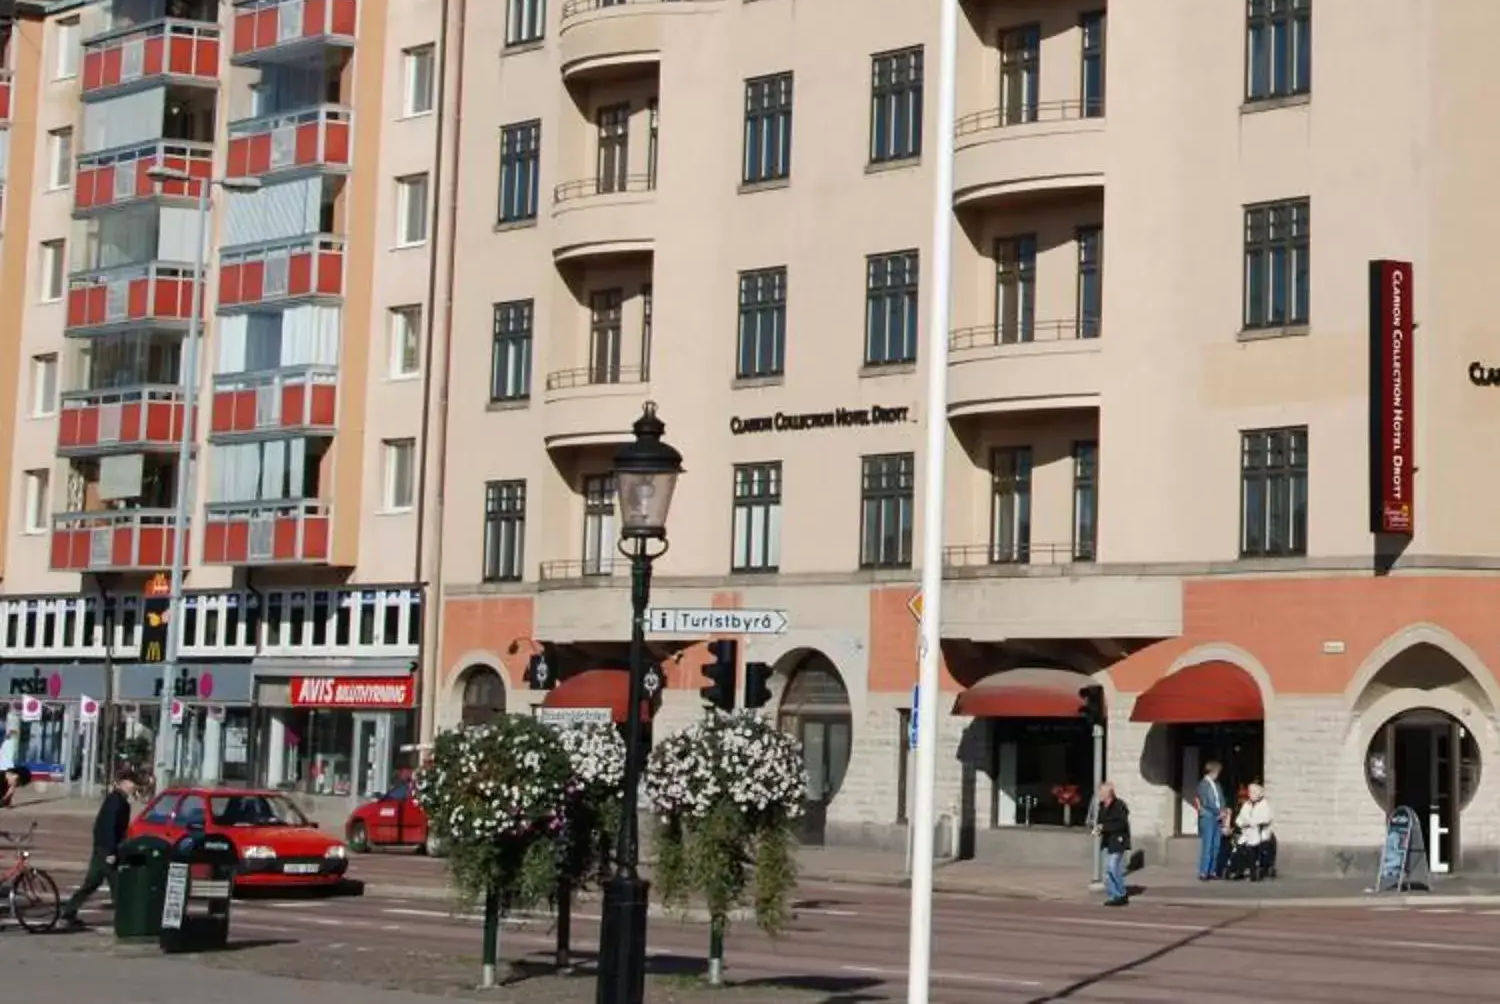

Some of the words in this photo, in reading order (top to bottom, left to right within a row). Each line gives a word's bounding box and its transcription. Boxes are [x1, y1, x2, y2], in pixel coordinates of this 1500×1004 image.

[1392, 329, 1404, 407] COLLECTION
[1392, 409, 1404, 453] HOTEL
[1392, 455, 1404, 499] DROTT
[681, 613, 772, 631] Turistbyrå
[9, 667, 48, 694] resia
[153, 668, 197, 696] rsia
[298, 677, 335, 703] AVIS
